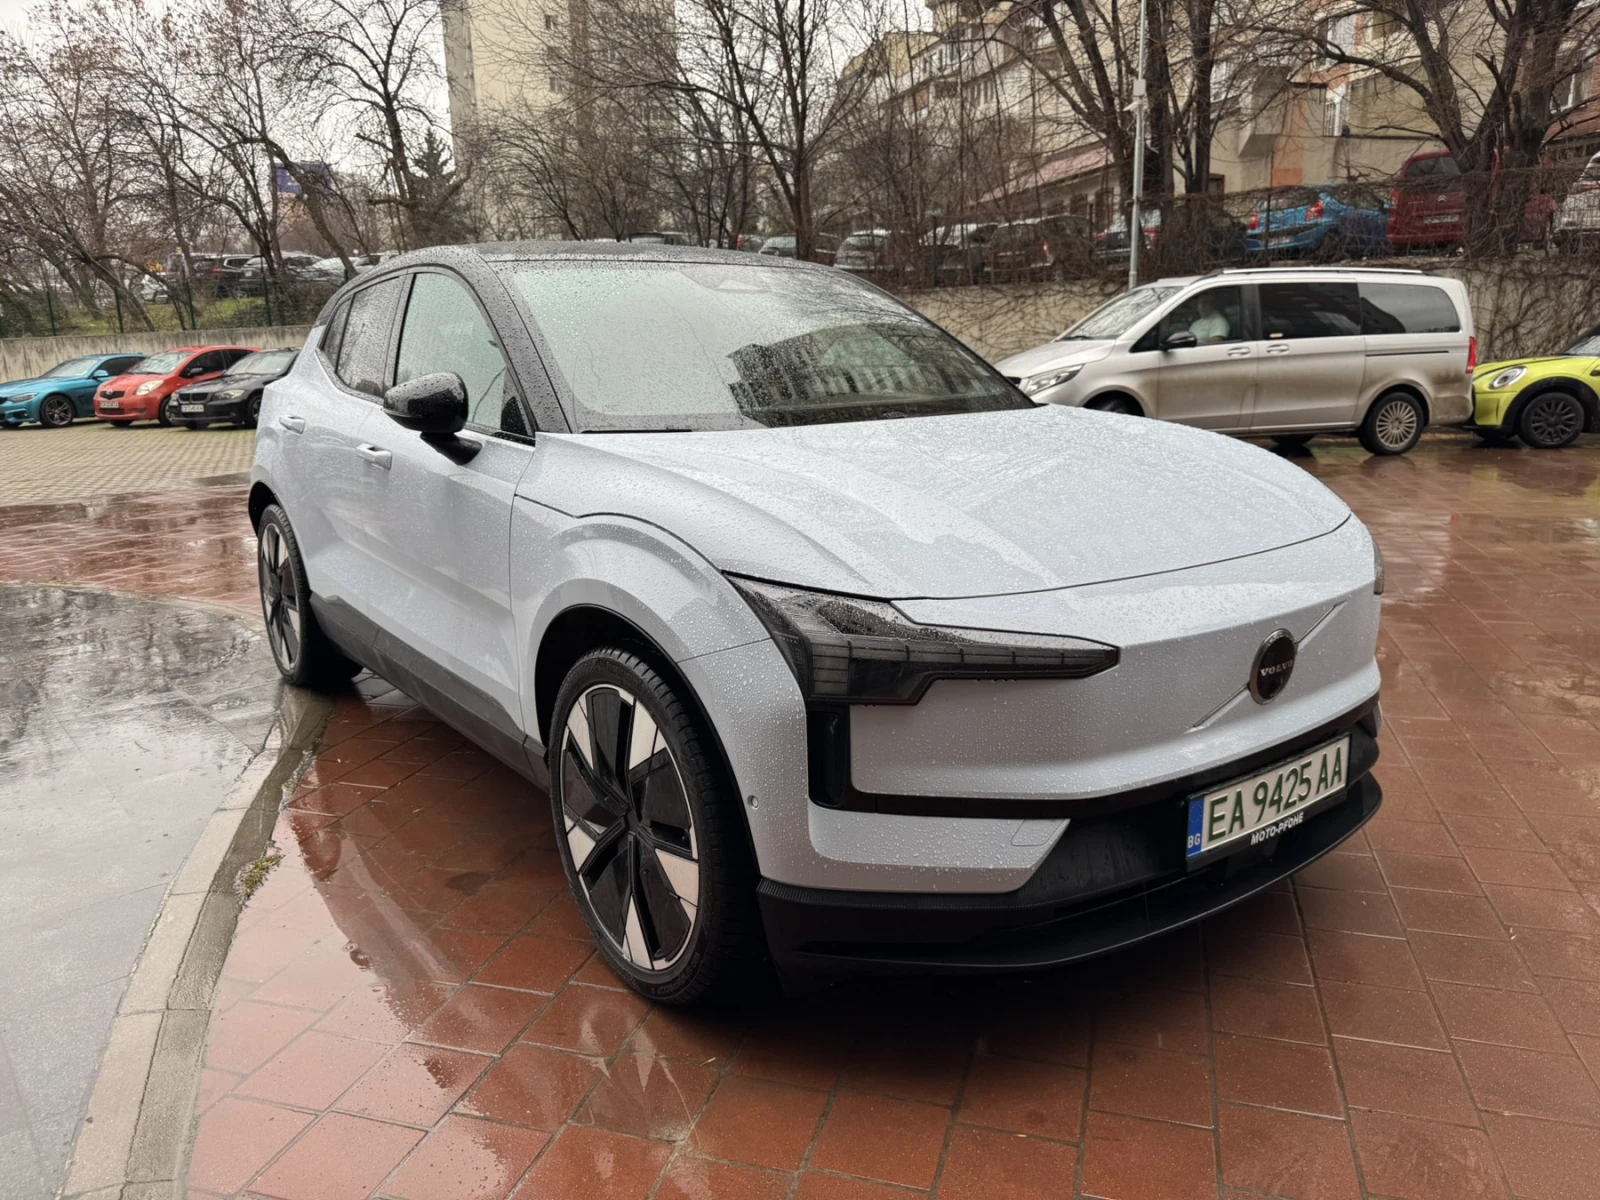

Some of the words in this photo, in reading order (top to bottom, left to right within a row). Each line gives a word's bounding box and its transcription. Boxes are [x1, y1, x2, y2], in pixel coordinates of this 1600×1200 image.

[1260, 660, 1293, 676] VOLVO
[1208, 790, 1245, 842] EA
[1253, 760, 1312, 824] 9425
[1315, 747, 1342, 795] AA
[1187, 833, 1201, 849] BG
[1250, 812, 1304, 846] MOTO-PFOHE
